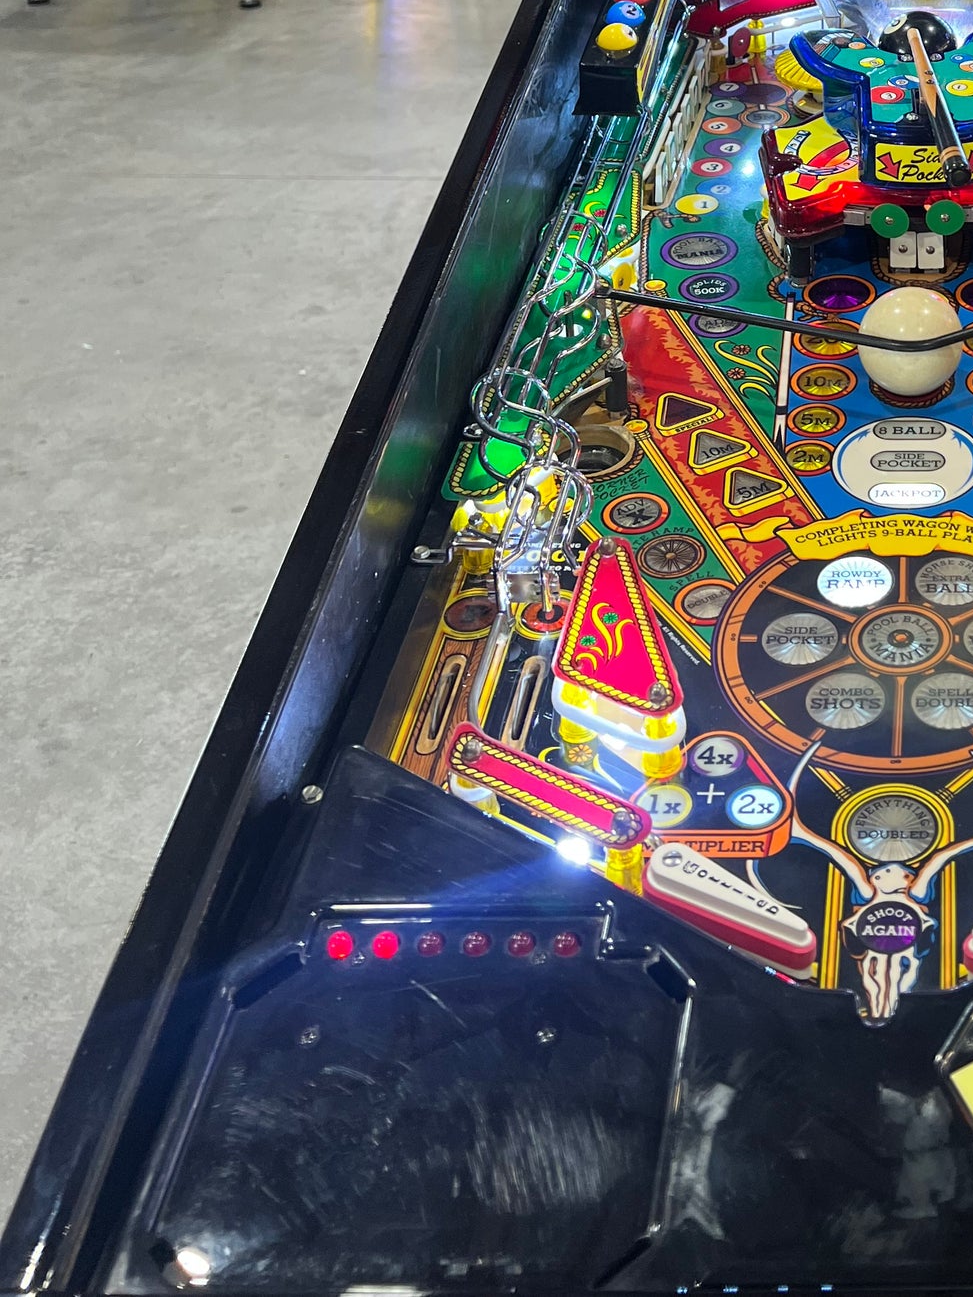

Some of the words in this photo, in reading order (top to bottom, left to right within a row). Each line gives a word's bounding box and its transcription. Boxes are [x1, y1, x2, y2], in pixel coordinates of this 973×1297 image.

[725, 145, 734, 153] 4
[913, 148, 944, 163] Sid
[706, 163, 718, 171] 3
[901, 164, 947, 181] Pock
[716, 186, 727, 194] 2
[676, 249, 724, 259] MANIA
[692, 279, 726, 288] SOLIDS
[694, 286, 725, 295] 500K
[675, 416, 713, 433] SPECIAL
[801, 413, 830, 426] 5M
[879, 427, 888, 435] 8
[892, 427, 941, 435] BALL
[702, 443, 734, 460] 10M
[793, 450, 824, 463] 2M
[878, 460, 941, 468] POCKET
[738, 482, 771, 499] 5M
[875, 490, 941, 498] JACKPOT
[616, 499, 645, 515] ADV
[625, 509, 653, 525] X
[652, 527, 695, 537] RAMP
[795, 519, 897, 543] COMPLETING
[903, 519, 960, 532] WAGON
[818, 531, 877, 547] LIGHTS
[882, 529, 937, 538] 9-BALL
[831, 570, 882, 579] ROWDY
[920, 560, 953, 579] HORSE
[669, 571, 714, 591] SPELL
[687, 590, 729, 610] DOUBLE
[785, 626, 817, 635] SIDE
[868, 616, 899, 636] POOL
[904, 615, 935, 636] BALL
[766, 635, 834, 645] POCKET
[870, 642, 933, 662] MANIA
[819, 688, 874, 696] COMBO
[928, 688, 973, 697] SPELL
[810, 698, 881, 709] SHOTS
[697, 746, 734, 765] 4x
[648, 794, 682, 814] 1x
[737, 794, 775, 814] 2x
[856, 799, 930, 827] EVERYTHING
[857, 830, 930, 839] DOUBLED
[643, 840, 765, 853] MTIPLIER
[867, 908, 913, 923] SHOOT
[862, 925, 915, 937] AGAIN
